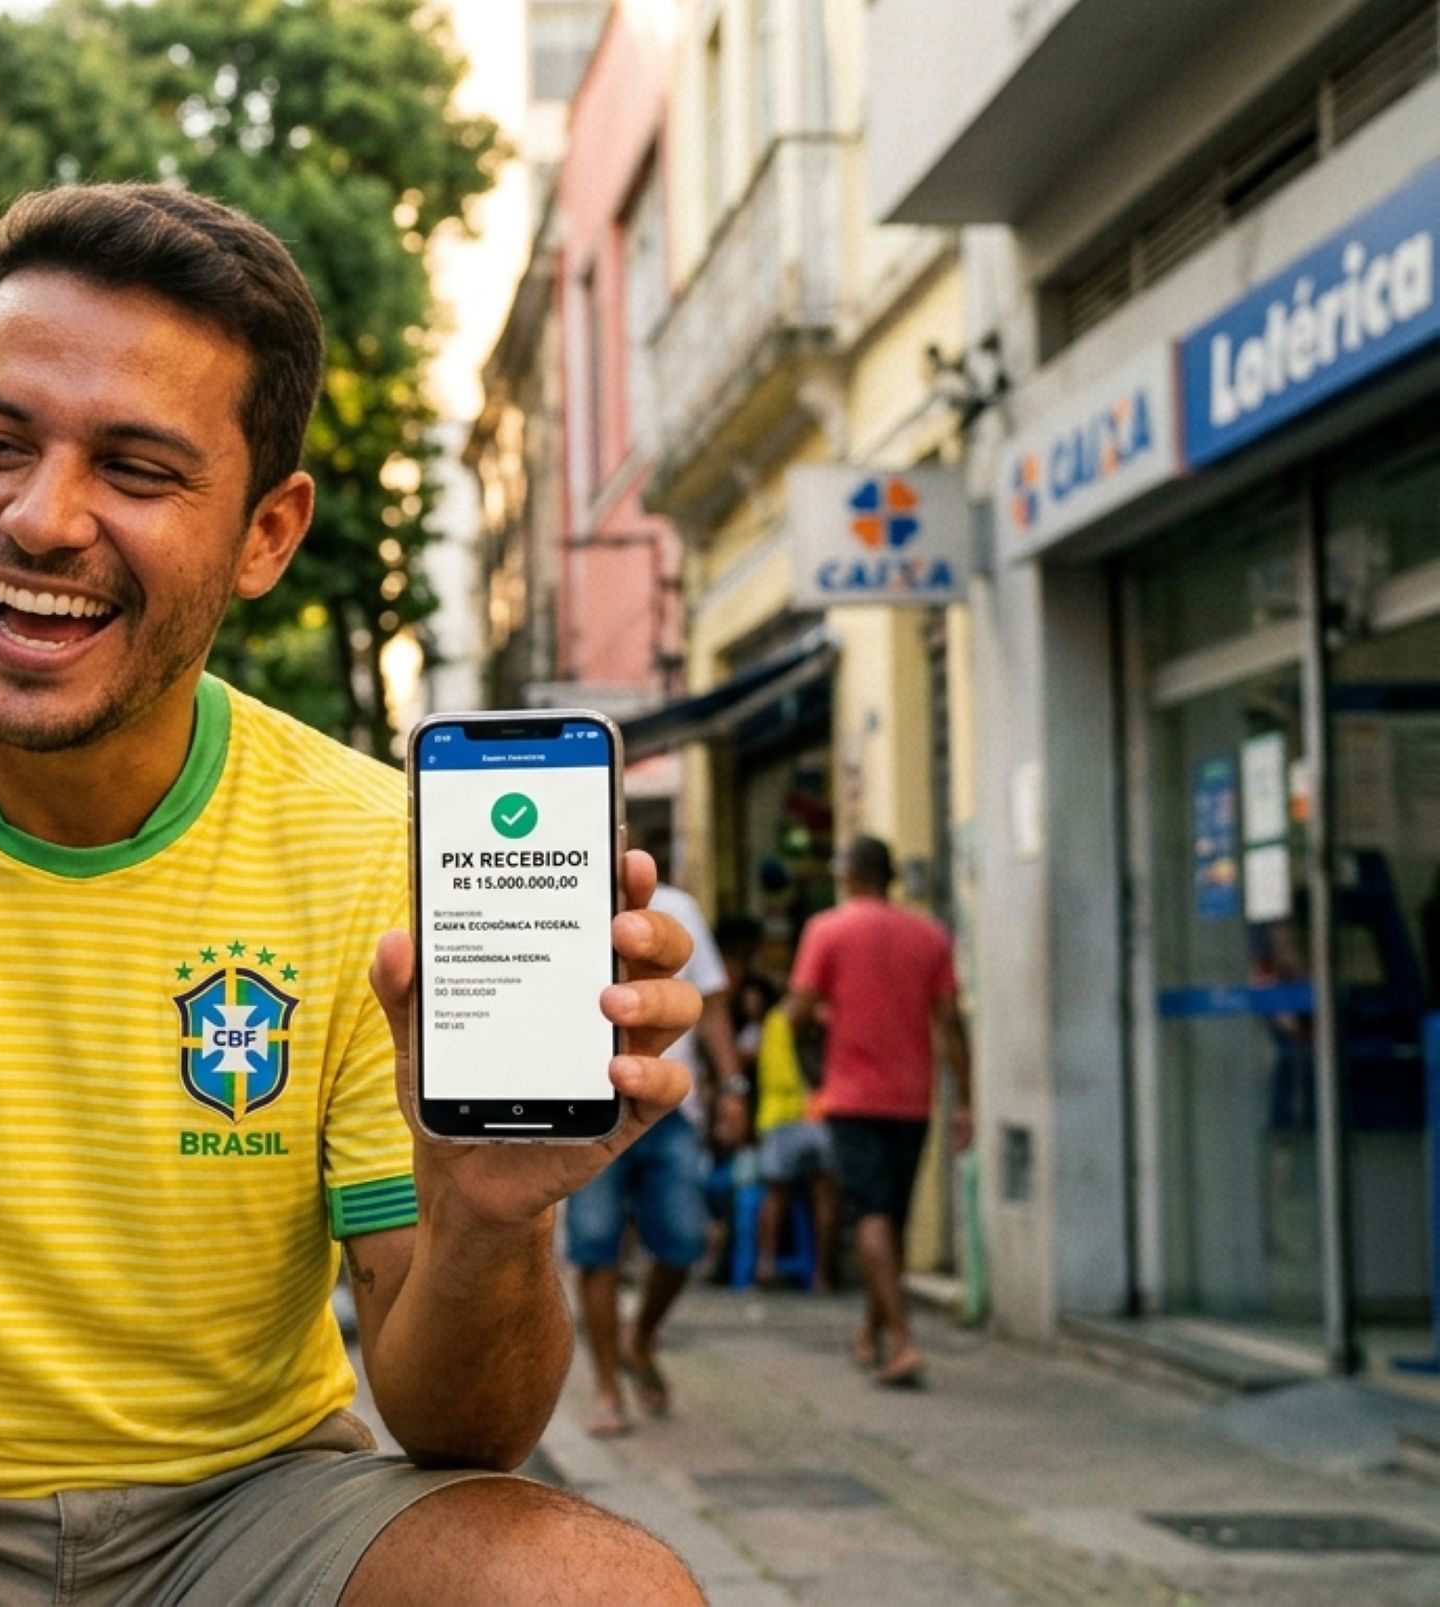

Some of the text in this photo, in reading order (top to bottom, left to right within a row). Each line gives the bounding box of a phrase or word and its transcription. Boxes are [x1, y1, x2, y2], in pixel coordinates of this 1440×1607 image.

[1210, 231, 1433, 428] Lotérica
[1049, 388, 1152, 503] CAIXA
[817, 559, 954, 592] CAIXA
[442, 850, 588, 868] PIX RECEBIDO!
[476, 875, 578, 890] 15.000.000,00
[212, 1030, 258, 1048] CBF
[179, 1131, 289, 1156] BRASIL
